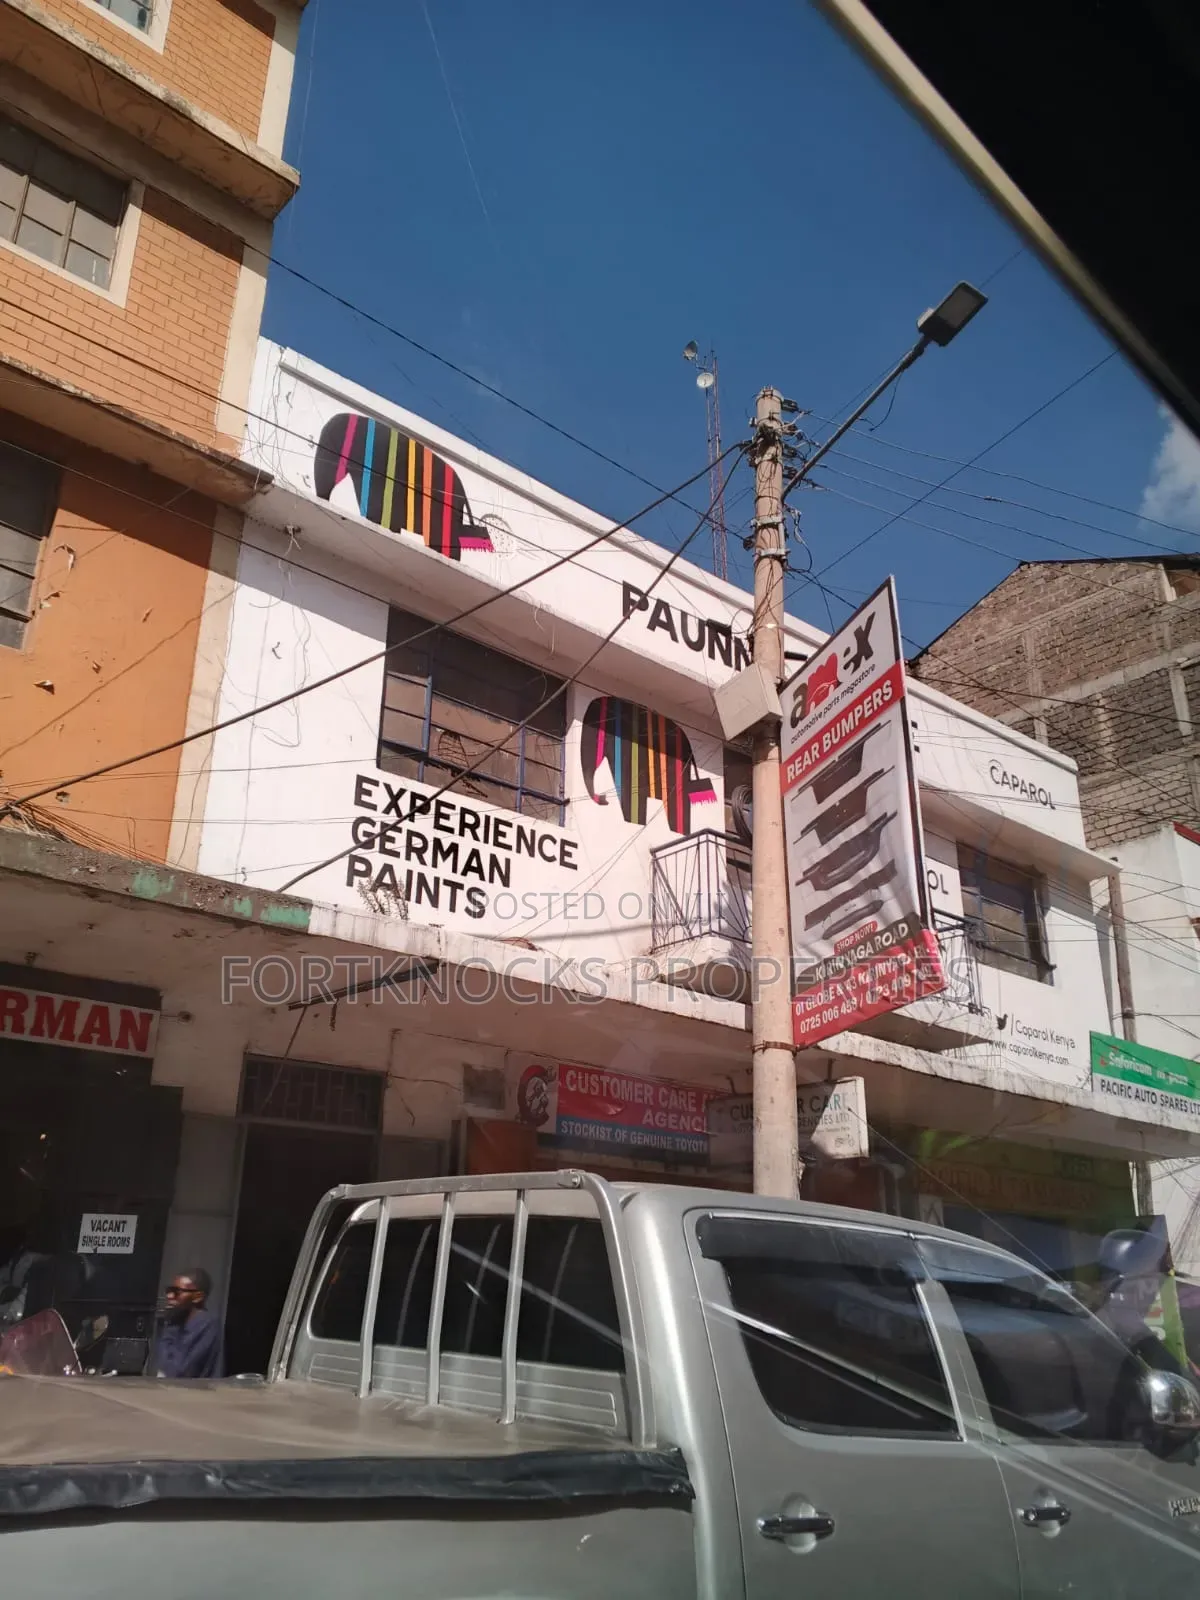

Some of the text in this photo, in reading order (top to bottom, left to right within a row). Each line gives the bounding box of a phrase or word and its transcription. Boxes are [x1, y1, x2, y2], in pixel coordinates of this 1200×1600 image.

[790, 664, 876, 745] automotive parts megastore
[786, 679, 894, 784] REAR BUMPERS
[990, 764, 1057, 811] CAPAROL
[353, 773, 578, 871] EXPERIENCE
[351, 815, 511, 889] GERMAN
[346, 853, 486, 919] PAINTS
[836, 936, 855, 952] SHOP
[875, 922, 909, 951] ROAD
[806, 985, 836, 1010] GLOBE
[0, 989, 153, 1052] RMAN
[800, 1013, 821, 1034] 0725
[822, 1005, 839, 1024] 006
[1015, 1020, 1077, 1052] Caparol Kenya
[1109, 1051, 1153, 1076] Safaricom
[565, 1069, 654, 1106] CUSTOMER
[658, 1086, 697, 1113] CARE
[1101, 1079, 1133, 1099] PACIFIC
[1134, 1088, 1158, 1105] AUTO
[1160, 1094, 1188, 1113] SPARES
[561, 1120, 612, 1142] STOCKIST
[614, 1130, 628, 1143] OF
[630, 1131, 673, 1148] GENUINE
[82, 1235, 131, 1248] SINGLE ROOMS
[91, 1219, 127, 1232] VACANT
